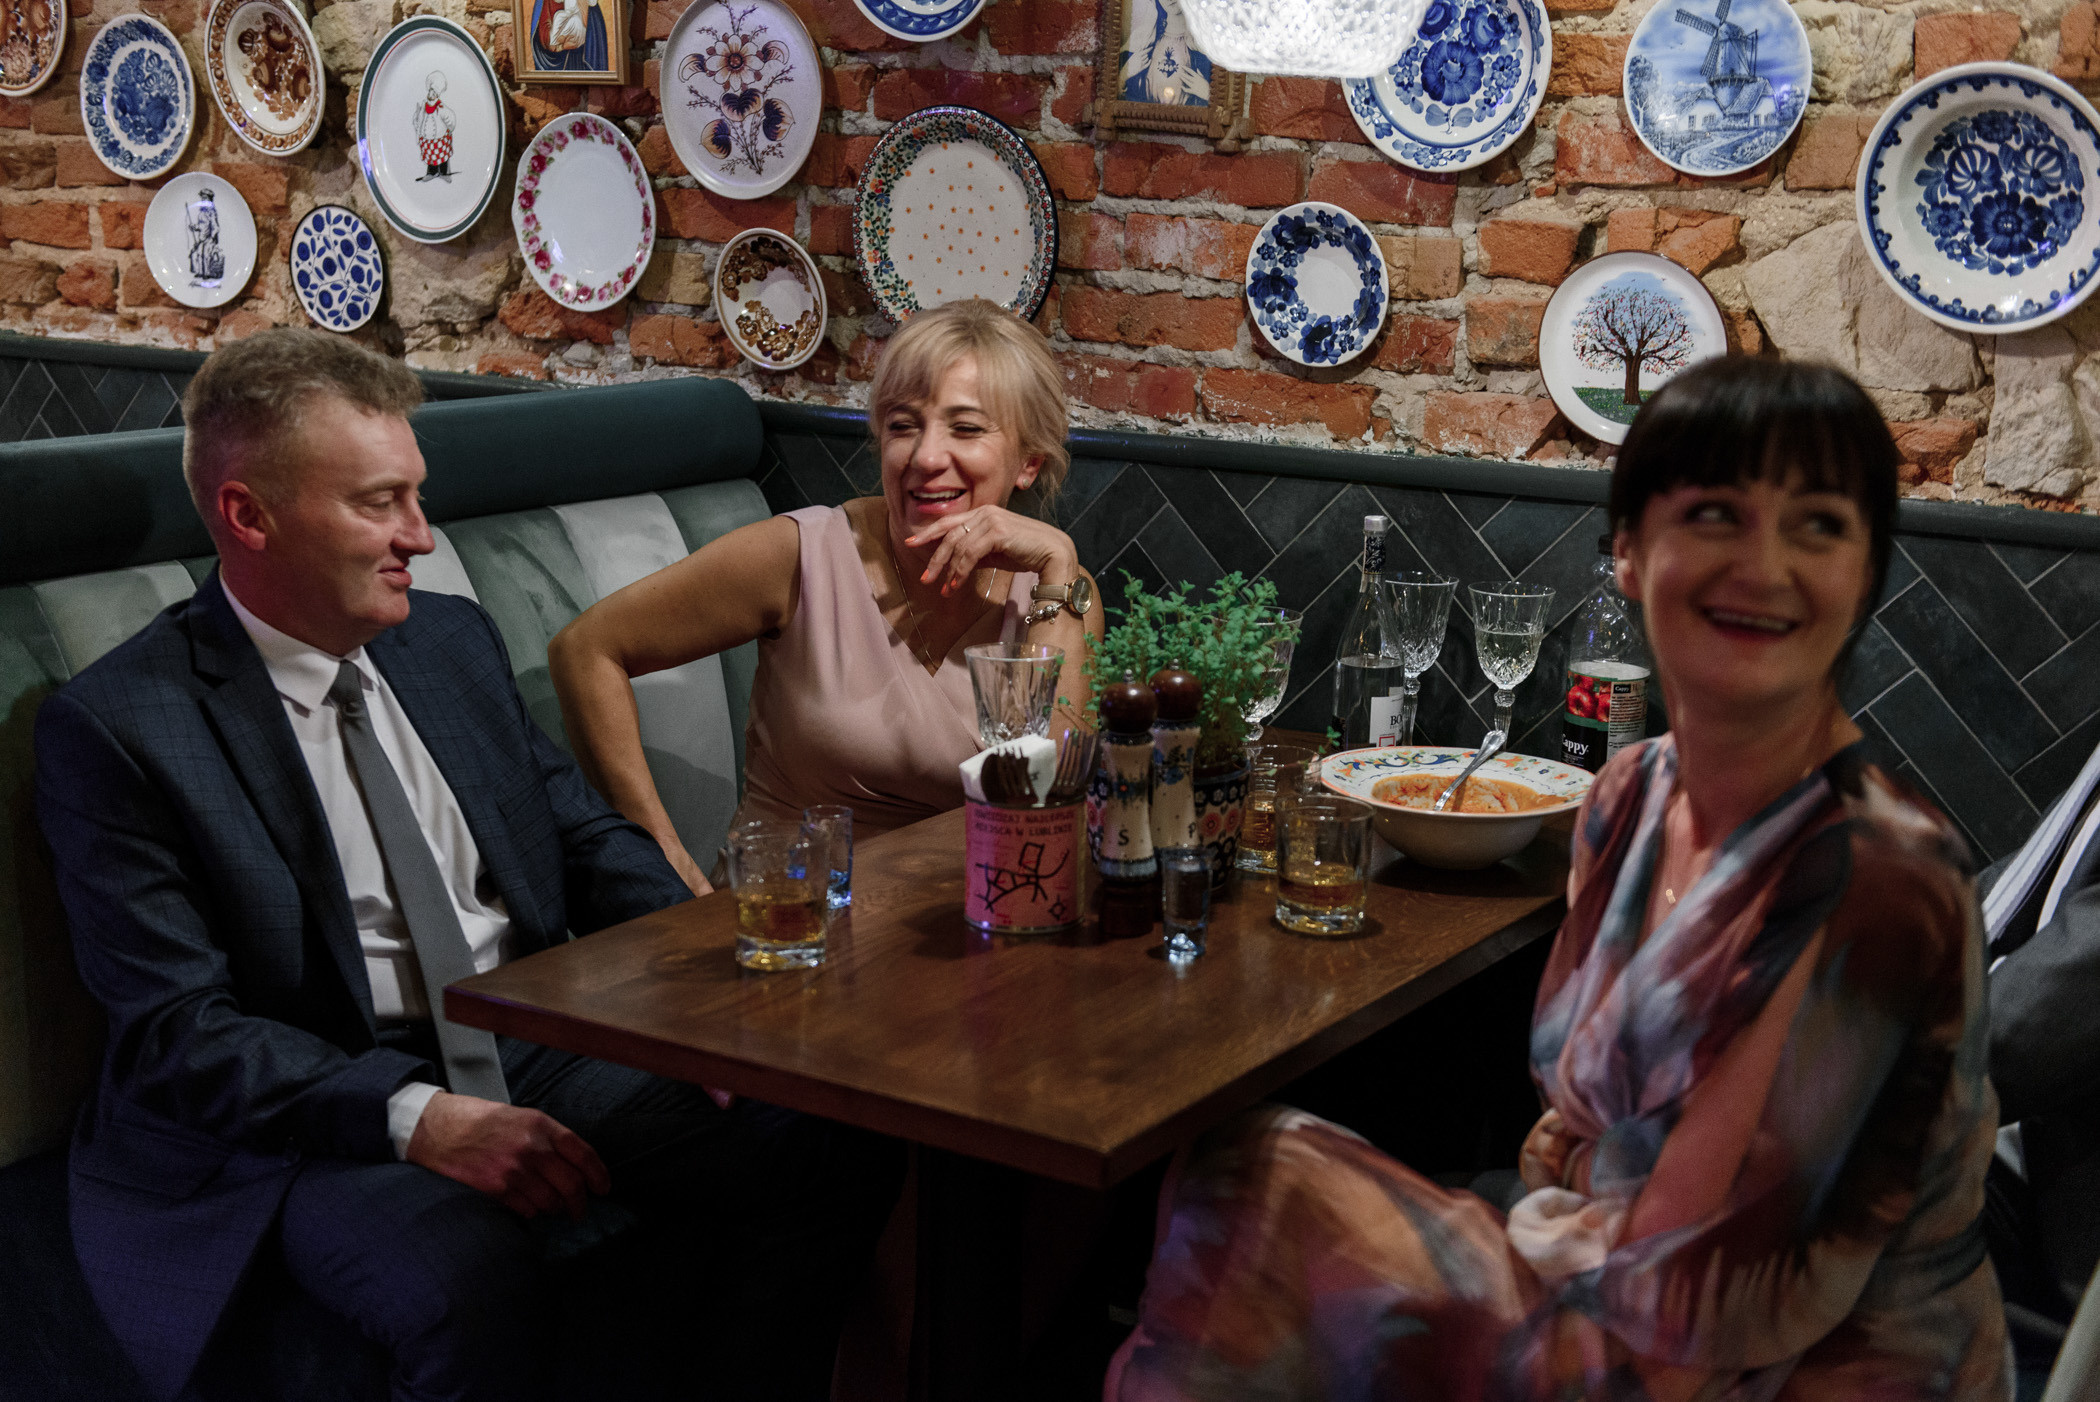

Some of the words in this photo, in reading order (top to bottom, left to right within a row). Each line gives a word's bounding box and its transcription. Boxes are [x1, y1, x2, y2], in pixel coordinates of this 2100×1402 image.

[1390, 714, 1403, 726] BO
[1118, 829, 1129, 846] S
[1188, 823, 1197, 839] P
